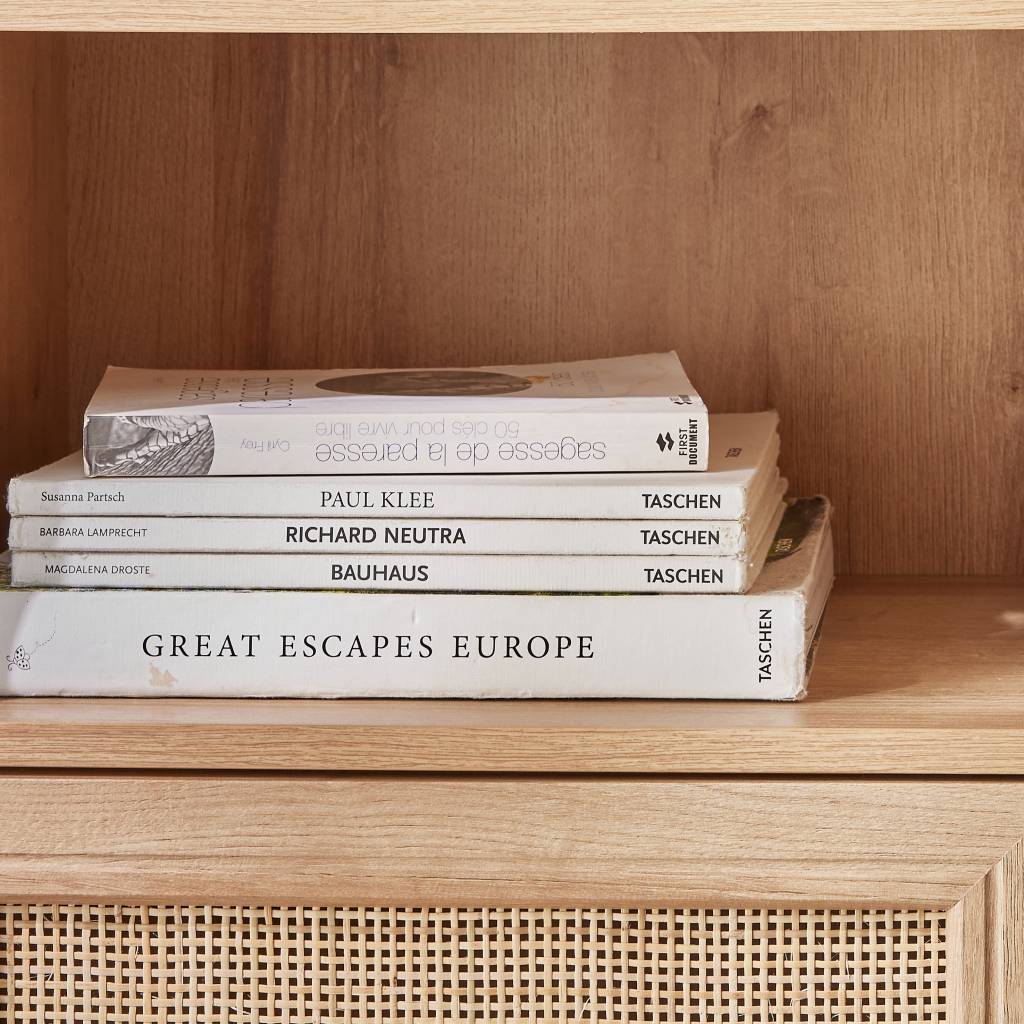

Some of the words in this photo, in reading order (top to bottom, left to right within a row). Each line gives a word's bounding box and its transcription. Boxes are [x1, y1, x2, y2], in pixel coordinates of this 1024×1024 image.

[314, 421, 352, 440] libre
[357, 421, 398, 439] vivre
[403, 416, 445, 436] pour
[494, 420, 520, 439] 50
[314, 437, 418, 463] paresse
[498, 435, 607, 461] sagesse
[678, 428, 688, 456] FIRST
[688, 418, 698, 466] DOCUMENT
[428, 442, 447, 466] la
[456, 440, 490, 467] de
[40, 491, 84, 503] Susanna
[87, 491, 125, 503] Partsch
[320, 491, 375, 509] PAUL
[380, 492, 435, 509] KLEE
[641, 493, 722, 510] TASCHEN
[39, 527, 85, 537] BARBARA
[87, 528, 148, 538] LAMPRECHT
[285, 526, 377, 544] RICHARD
[384, 527, 467, 545] NEUTRA
[640, 529, 721, 546] TASCHEN
[44, 564, 108, 575] MAGDALENA
[111, 565, 151, 575] DROSTE
[331, 564, 429, 582] BAUHAUS
[643, 568, 724, 584] TASCHEN
[142, 633, 261, 658] GREAT
[279, 634, 433, 659] ESCAPES
[452, 635, 595, 660] EUROPE
[758, 608, 773, 683] TASCHEN
